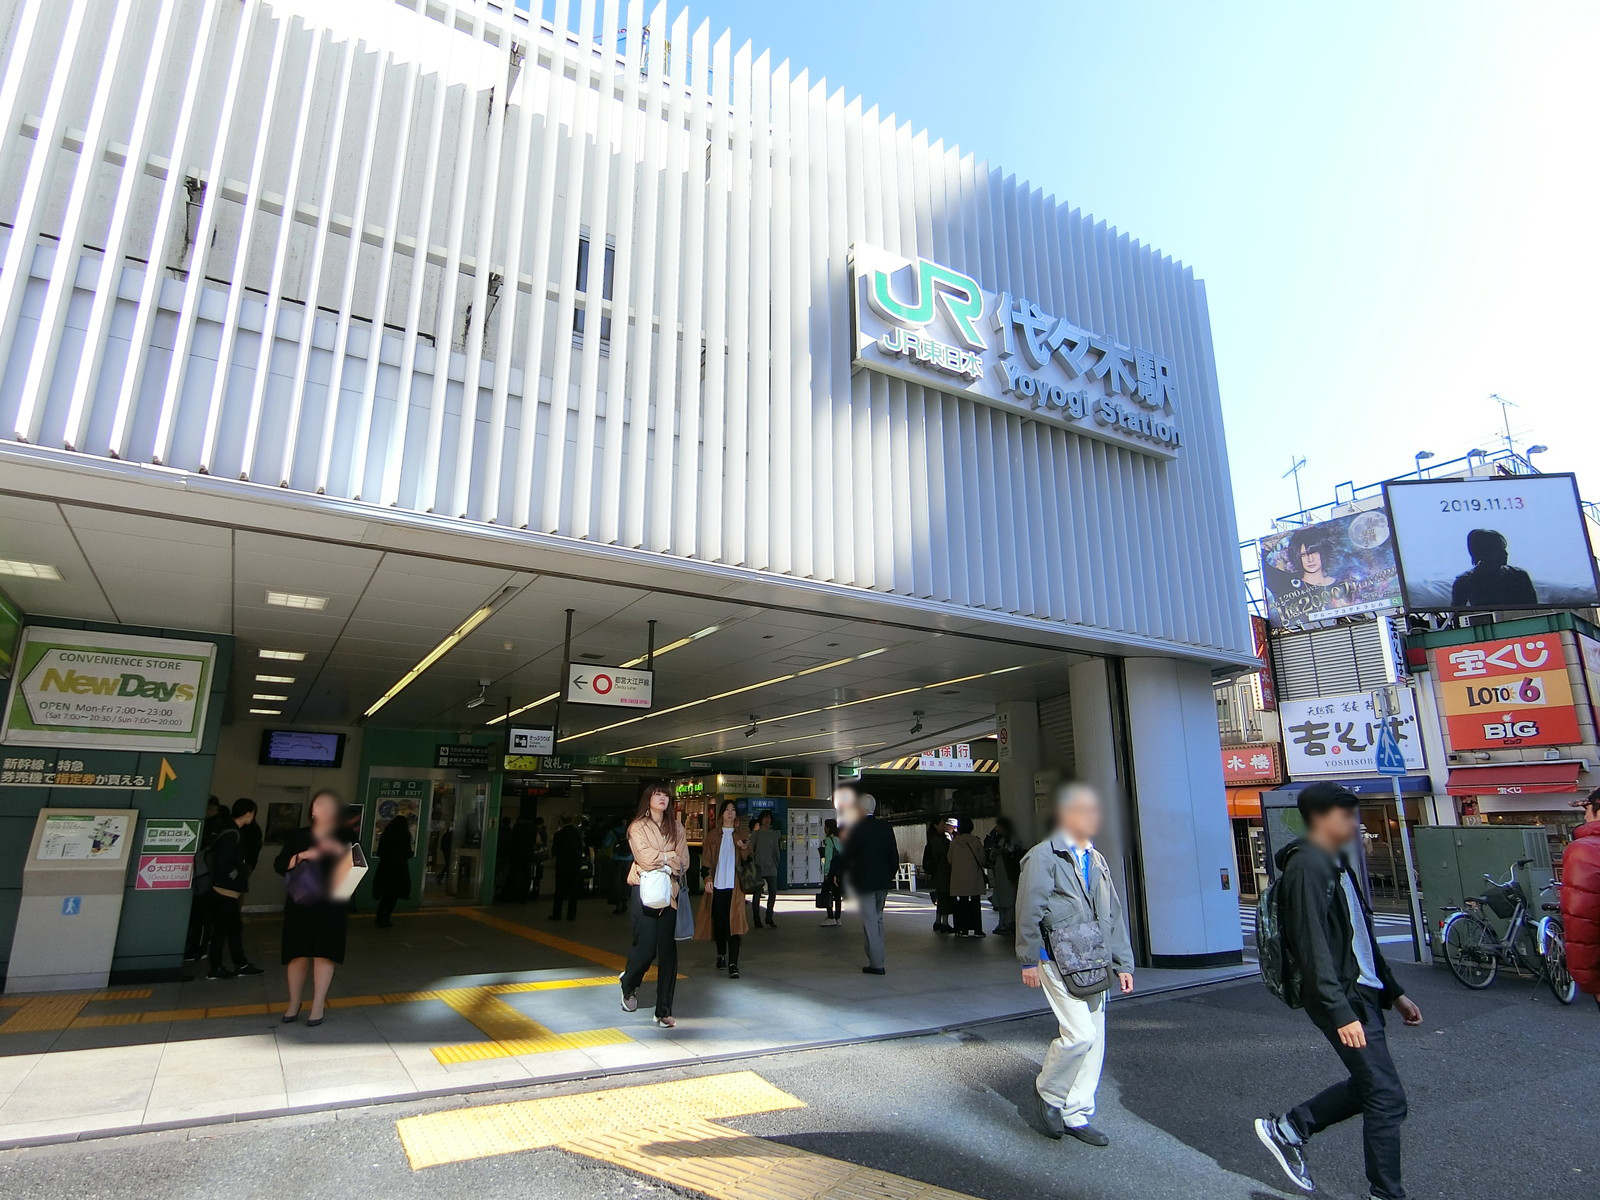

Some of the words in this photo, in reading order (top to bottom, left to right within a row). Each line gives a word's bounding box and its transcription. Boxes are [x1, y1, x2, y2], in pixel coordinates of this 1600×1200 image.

[872, 257, 988, 352] JR
[882, 329, 984, 381] JR東日本
[993, 291, 1179, 414] 代々木駅
[1000, 361, 1090, 420] Yoyogi
[1099, 397, 1183, 450] Station
[1440, 497, 1525, 513] 2019.11.13
[59, 652, 143, 669] CONVENIENCE
[146, 660, 182, 671] STORE
[1449, 641, 1549, 677] 宝くじ
[39, 667, 195, 703] NewDays
[1466, 686, 1511, 707] LOTO
[1519, 676, 1541, 703] 6
[39, 701, 71, 711] OPEN
[76, 703, 114, 714] Mon-Fri
[1483, 720, 1540, 740] BIG
[3, 757, 84, 772] 新幹線・特急
[1497, 786, 1522, 794] 宝くじ
